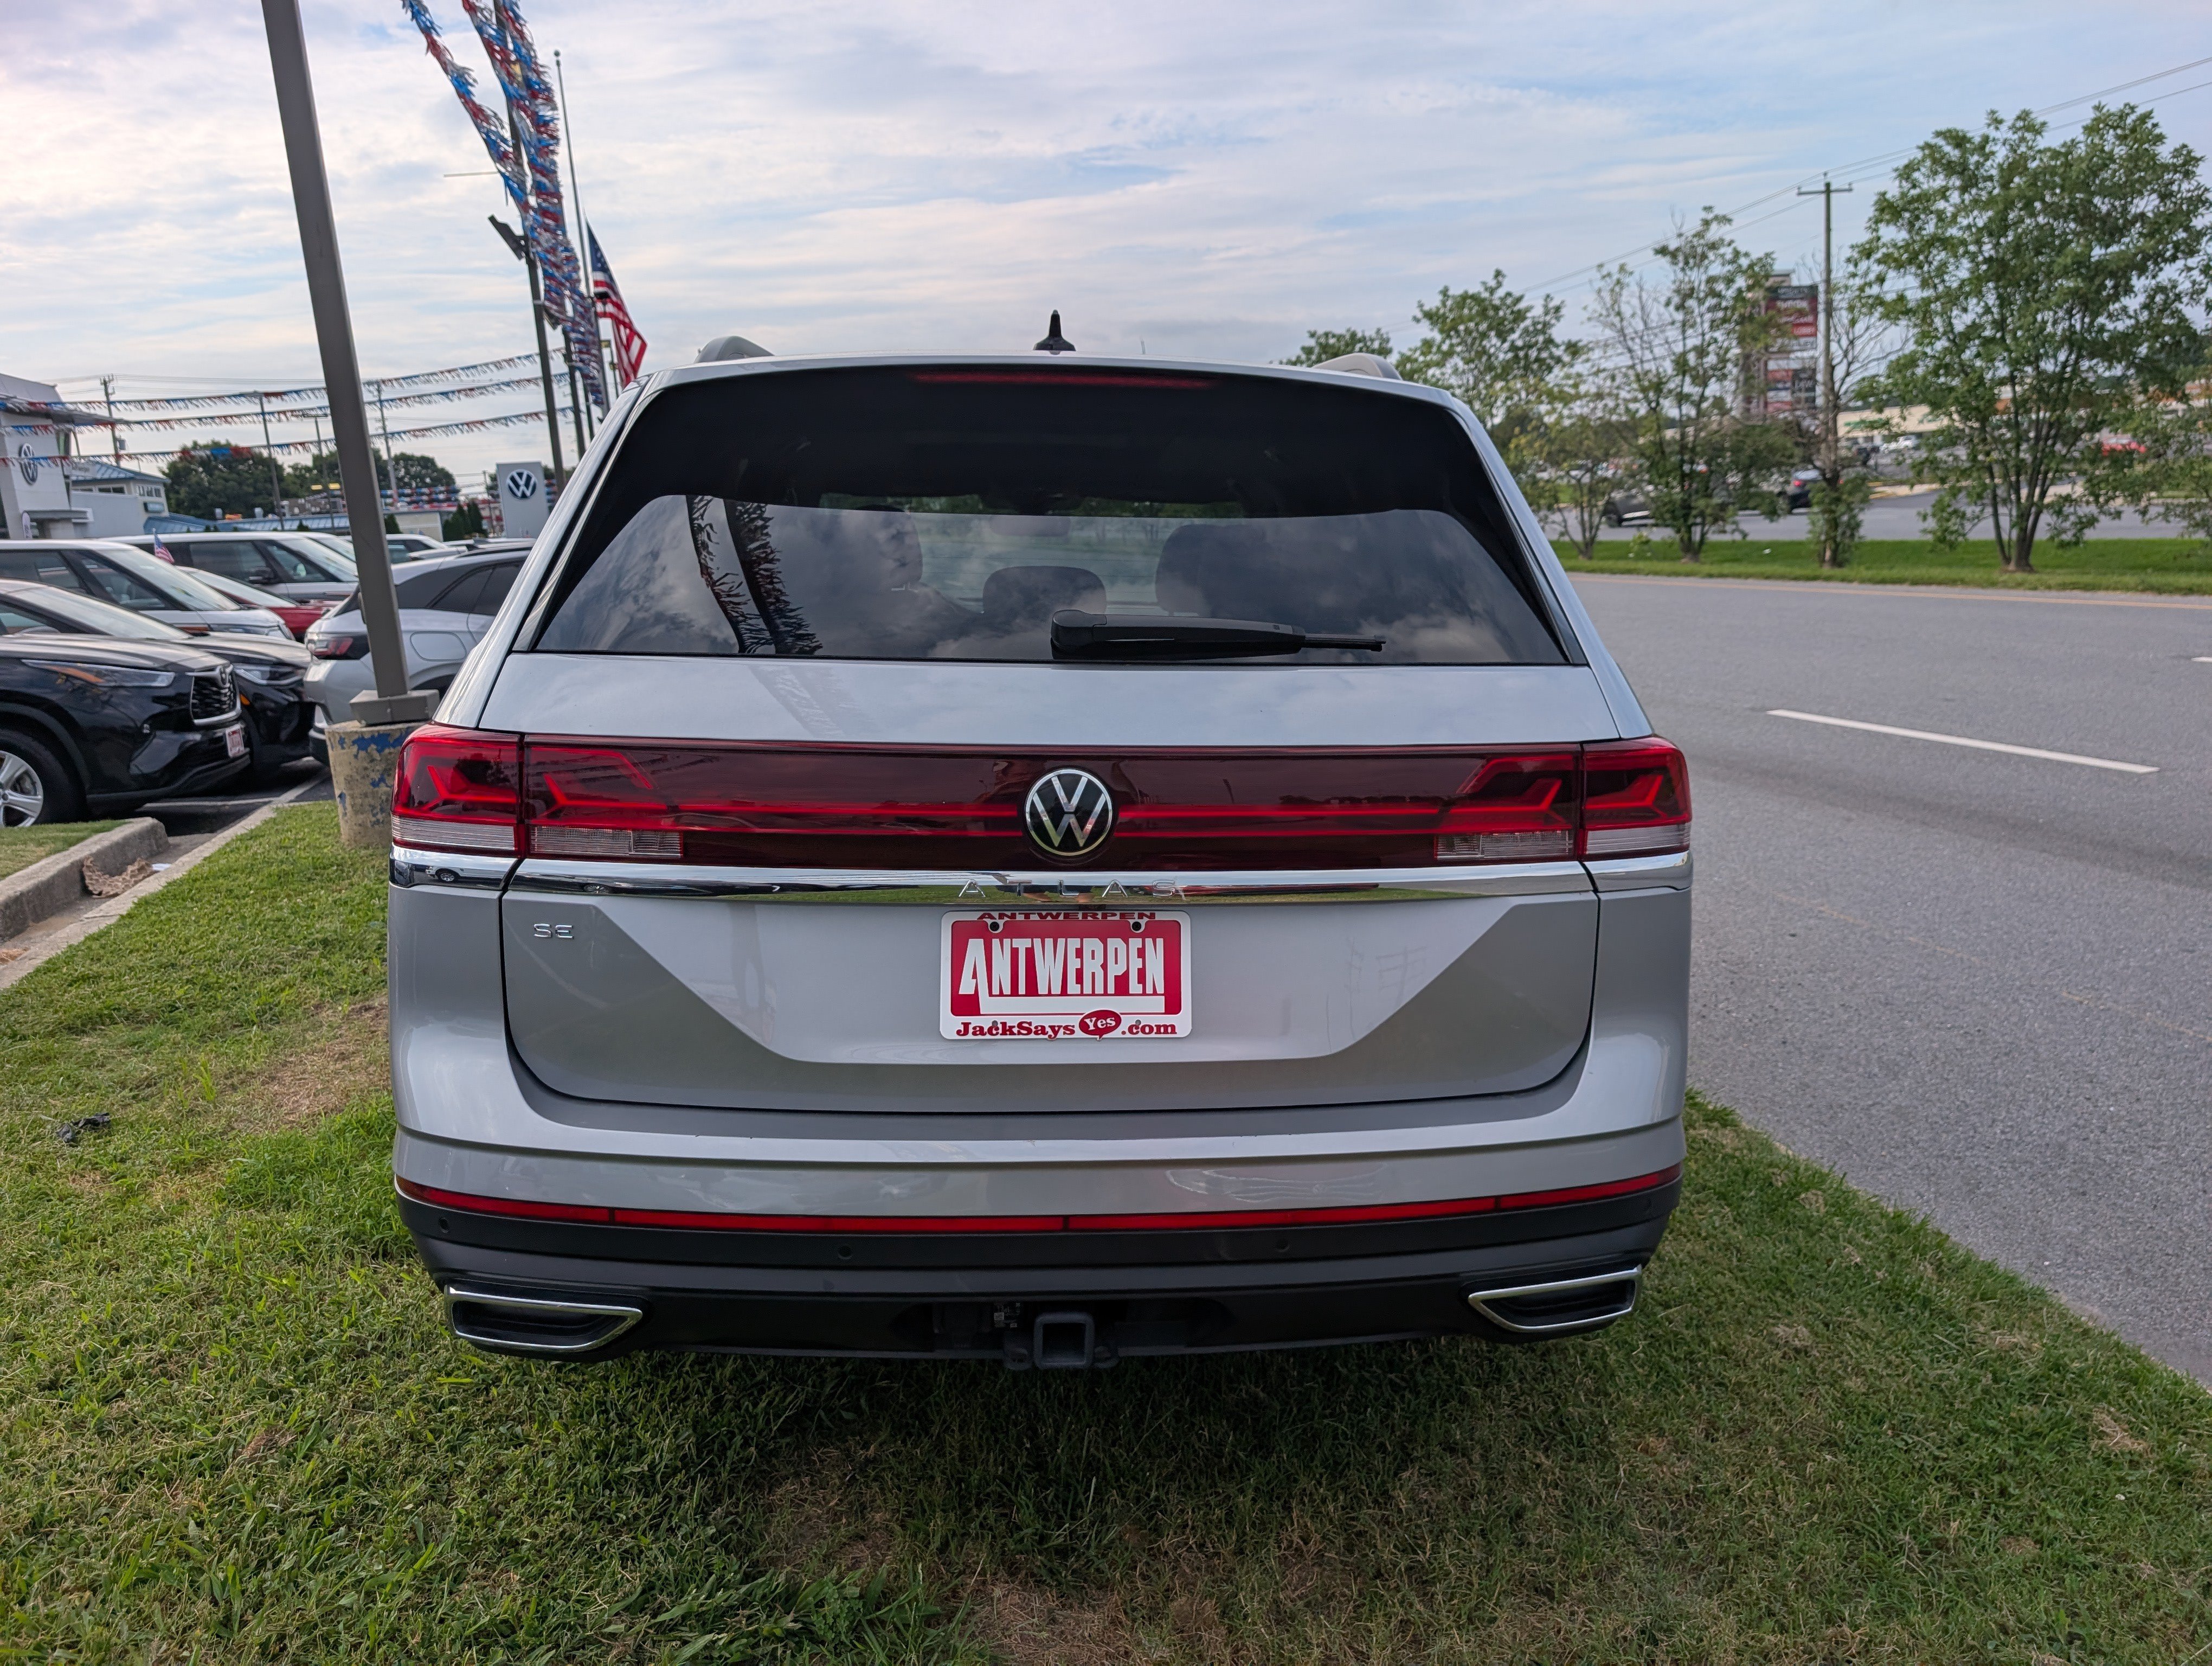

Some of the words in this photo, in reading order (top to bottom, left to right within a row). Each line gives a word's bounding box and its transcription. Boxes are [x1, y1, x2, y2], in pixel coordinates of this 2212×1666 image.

[958, 879, 1176, 898] ATLAS
[976, 912, 1156, 920] ANTWERPEN
[533, 923, 574, 939] SE
[958, 938, 1165, 996] ANTWERPEN
[956, 1021, 1076, 1039] JackSays
[1084, 1015, 1116, 1031] Yes
[1121, 1022, 1178, 1035] .com
